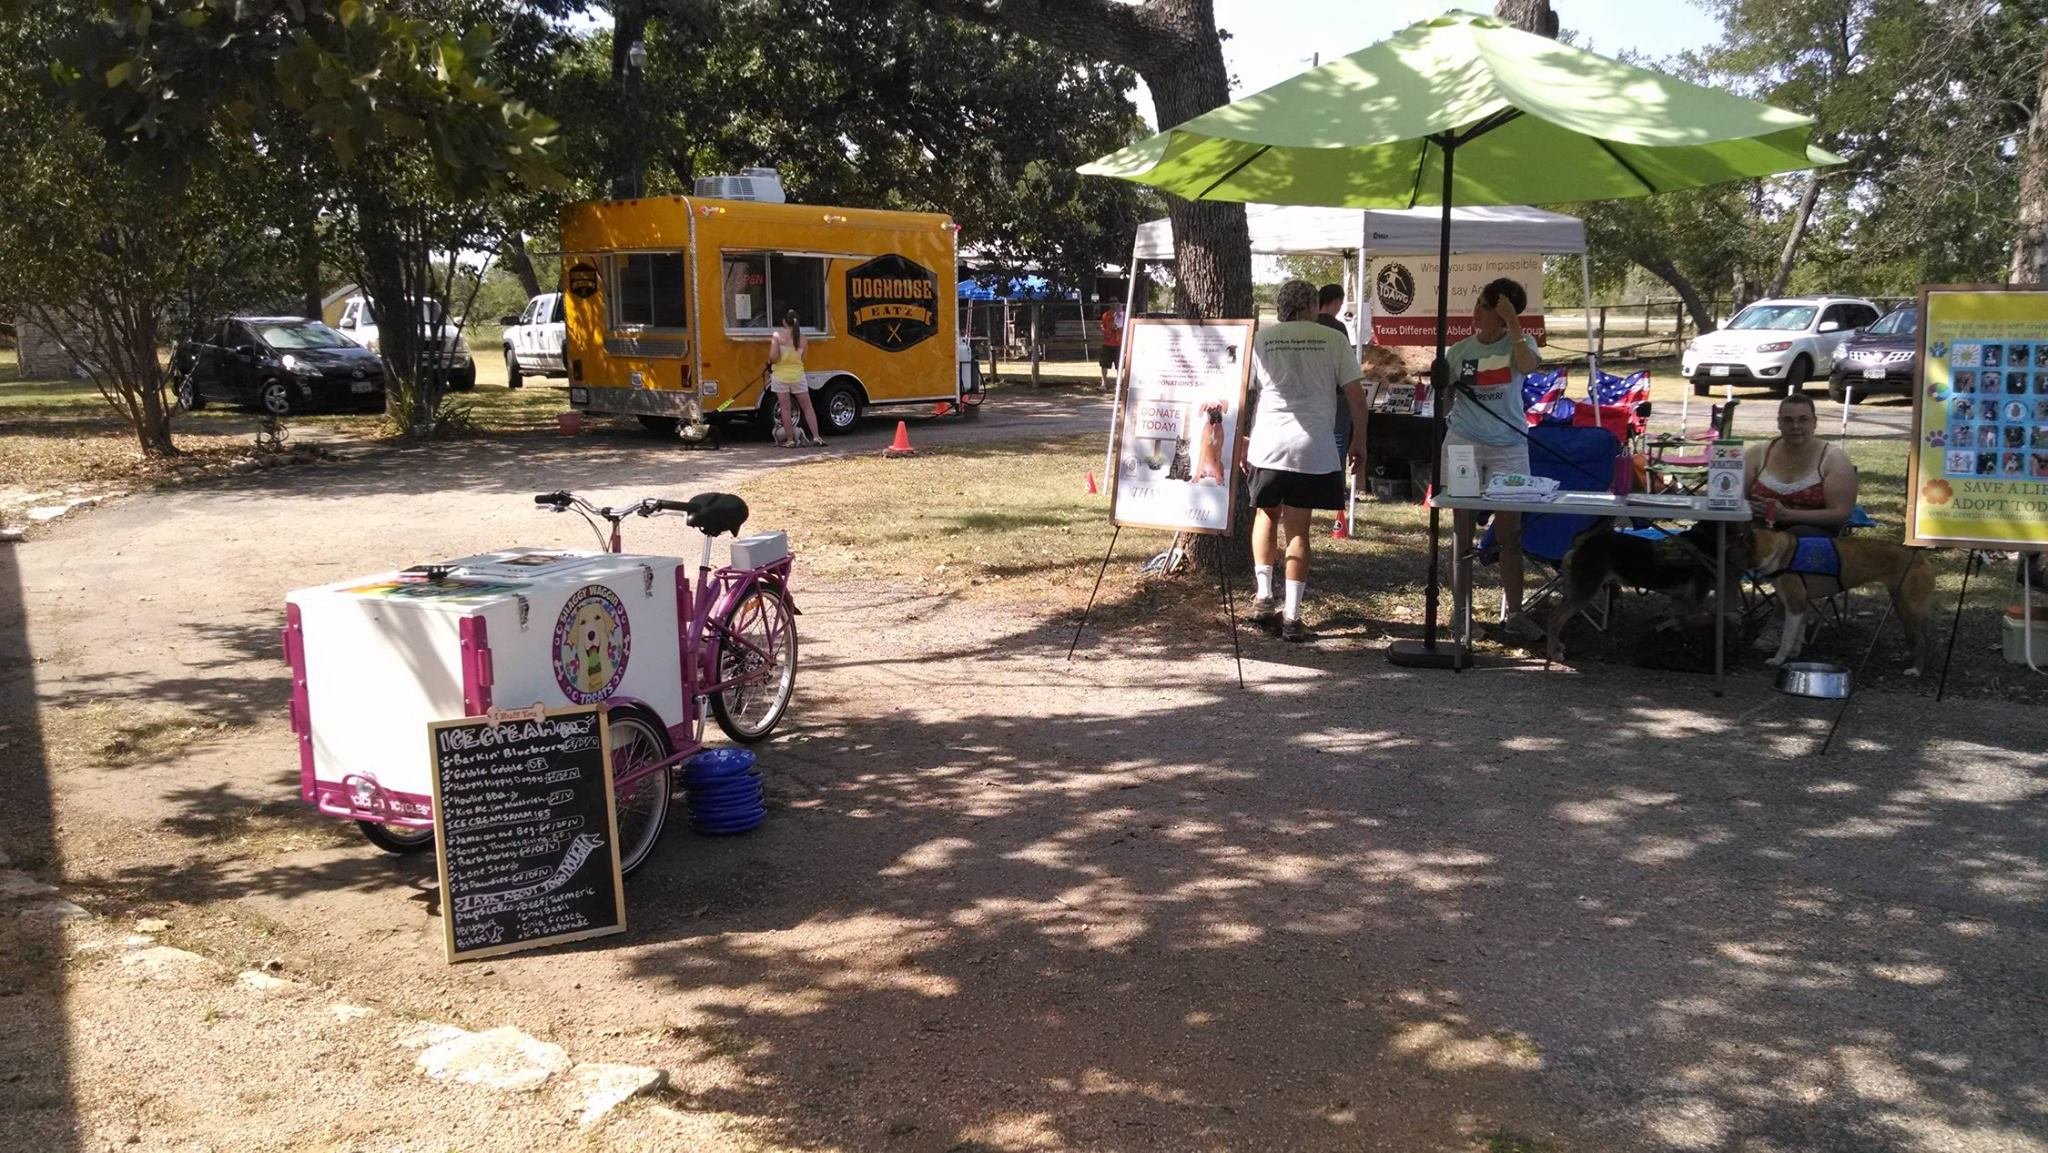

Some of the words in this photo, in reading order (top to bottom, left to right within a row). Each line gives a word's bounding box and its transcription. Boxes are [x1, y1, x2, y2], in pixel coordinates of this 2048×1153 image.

[1421, 263, 1441, 273] Whe
[1449, 264, 1464, 274] you
[1467, 263, 1482, 273] say
[852, 278, 933, 299] DOGHOUSE
[1379, 284, 1409, 304] TDAWG
[1451, 286, 1468, 297] say
[871, 305, 913, 317] EATZ
[1376, 324, 1398, 336] Texas
[1447, 324, 1471, 336] Abled
[1520, 326, 1545, 339] roup
[1141, 407, 1181, 419] DONATE
[1963, 481, 2004, 494] SAVE
[2008, 482, 2018, 495] A
[1952, 498, 2009, 511] ADOPT
[559, 588, 588, 624] SHAGGY
[579, 683, 614, 705] TREATS
[440, 728, 480, 752] ICE
[479, 720, 556, 747] CREAM
[503, 743, 565, 759] Blueberry
[454, 766, 488, 780] Gobble
[454, 779, 484, 792] Happy
[447, 819, 467, 830] ICE
[468, 814, 503, 827] CREAM
[503, 808, 551, 822] SAMMIES
[458, 868, 485, 880] Lone
